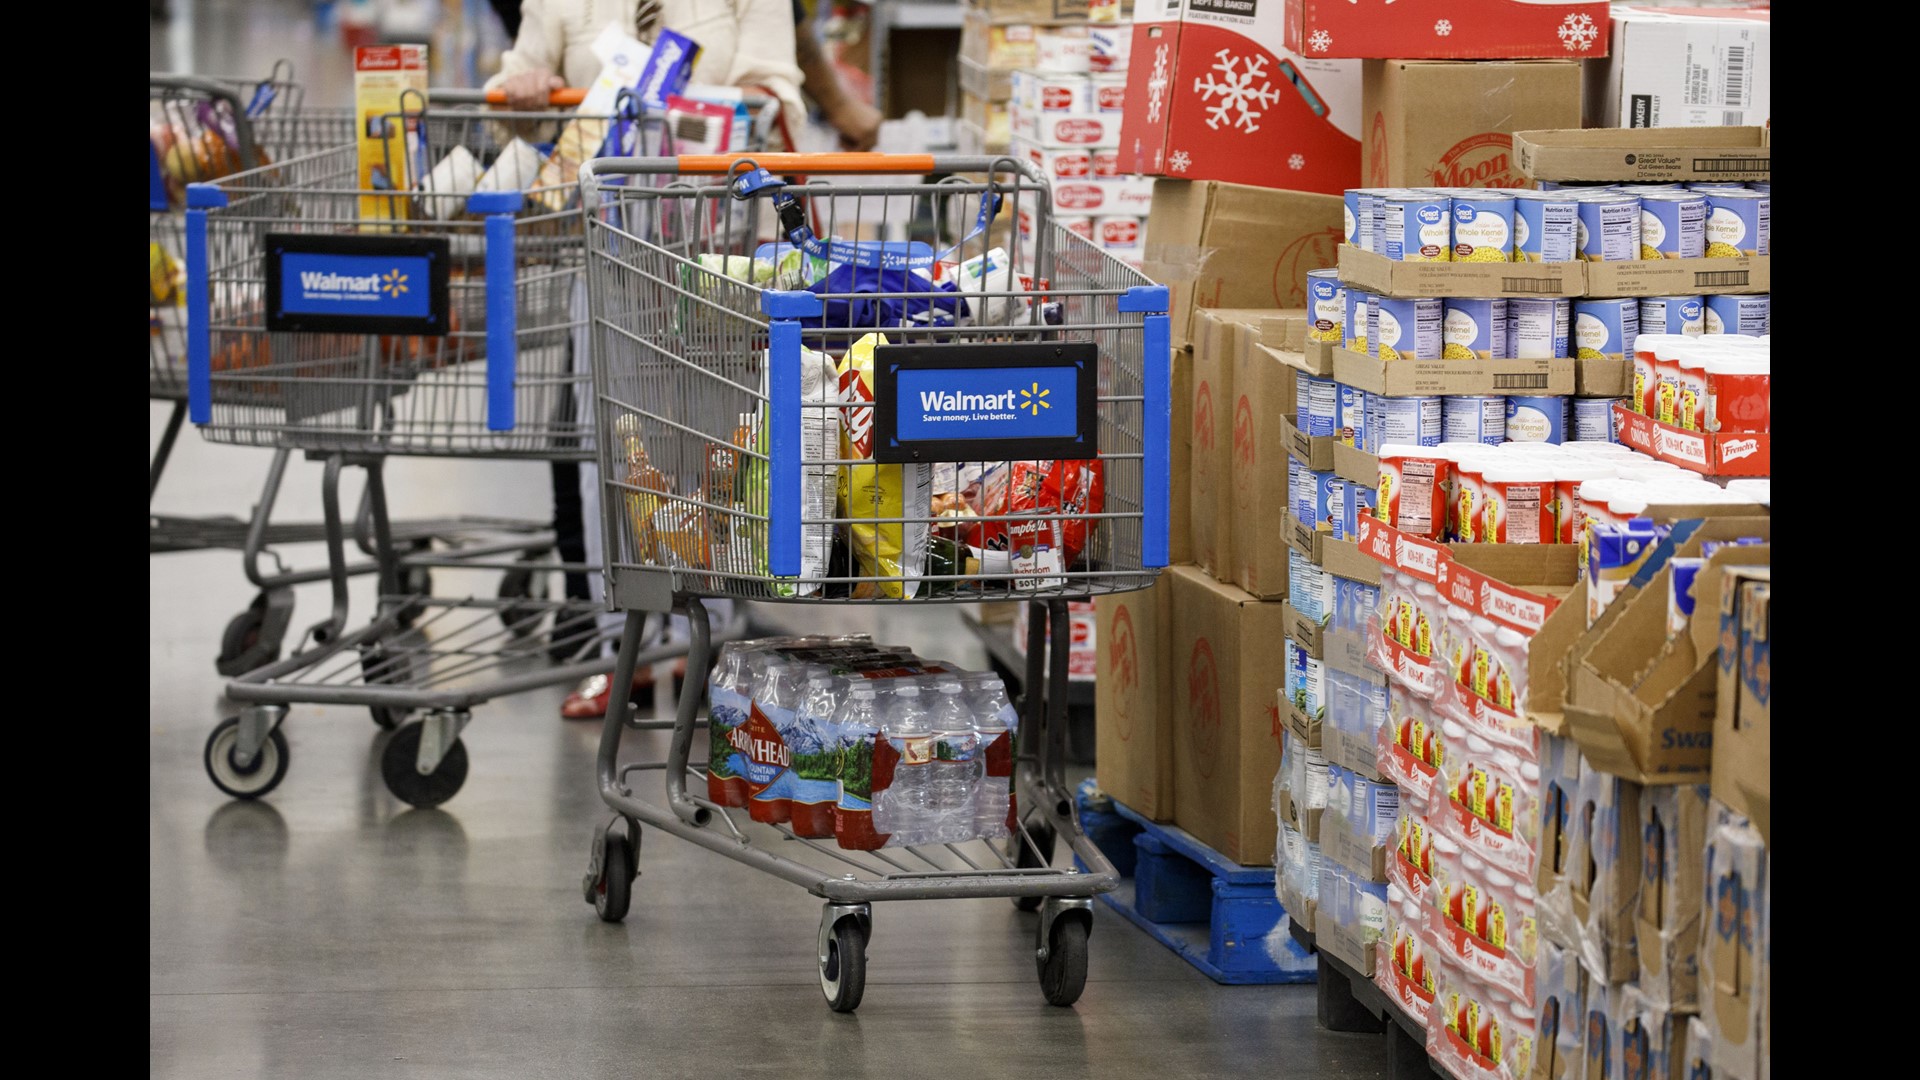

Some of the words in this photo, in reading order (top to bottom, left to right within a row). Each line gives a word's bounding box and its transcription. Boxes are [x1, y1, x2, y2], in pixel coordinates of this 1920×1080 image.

[1224, 0, 1254, 11] BAKERY
[1635, 98, 1646, 128] BAKERY
[1433, 153, 1508, 188] Moon
[1424, 229, 1444, 237] Whole
[1458, 228, 1478, 236] Whole
[301, 272, 380, 292] Walmart
[920, 390, 1016, 411] Walmart
[943, 414, 971, 422] money.
[1521, 423, 1544, 431] Kernel
[1631, 427, 1650, 447] ONIONS
[1724, 443, 1753, 456] French's
[1373, 537, 1390, 560] ONIONS
[1452, 582, 1474, 606] ONIONS
[750, 763, 775, 774] OUNTAIN
